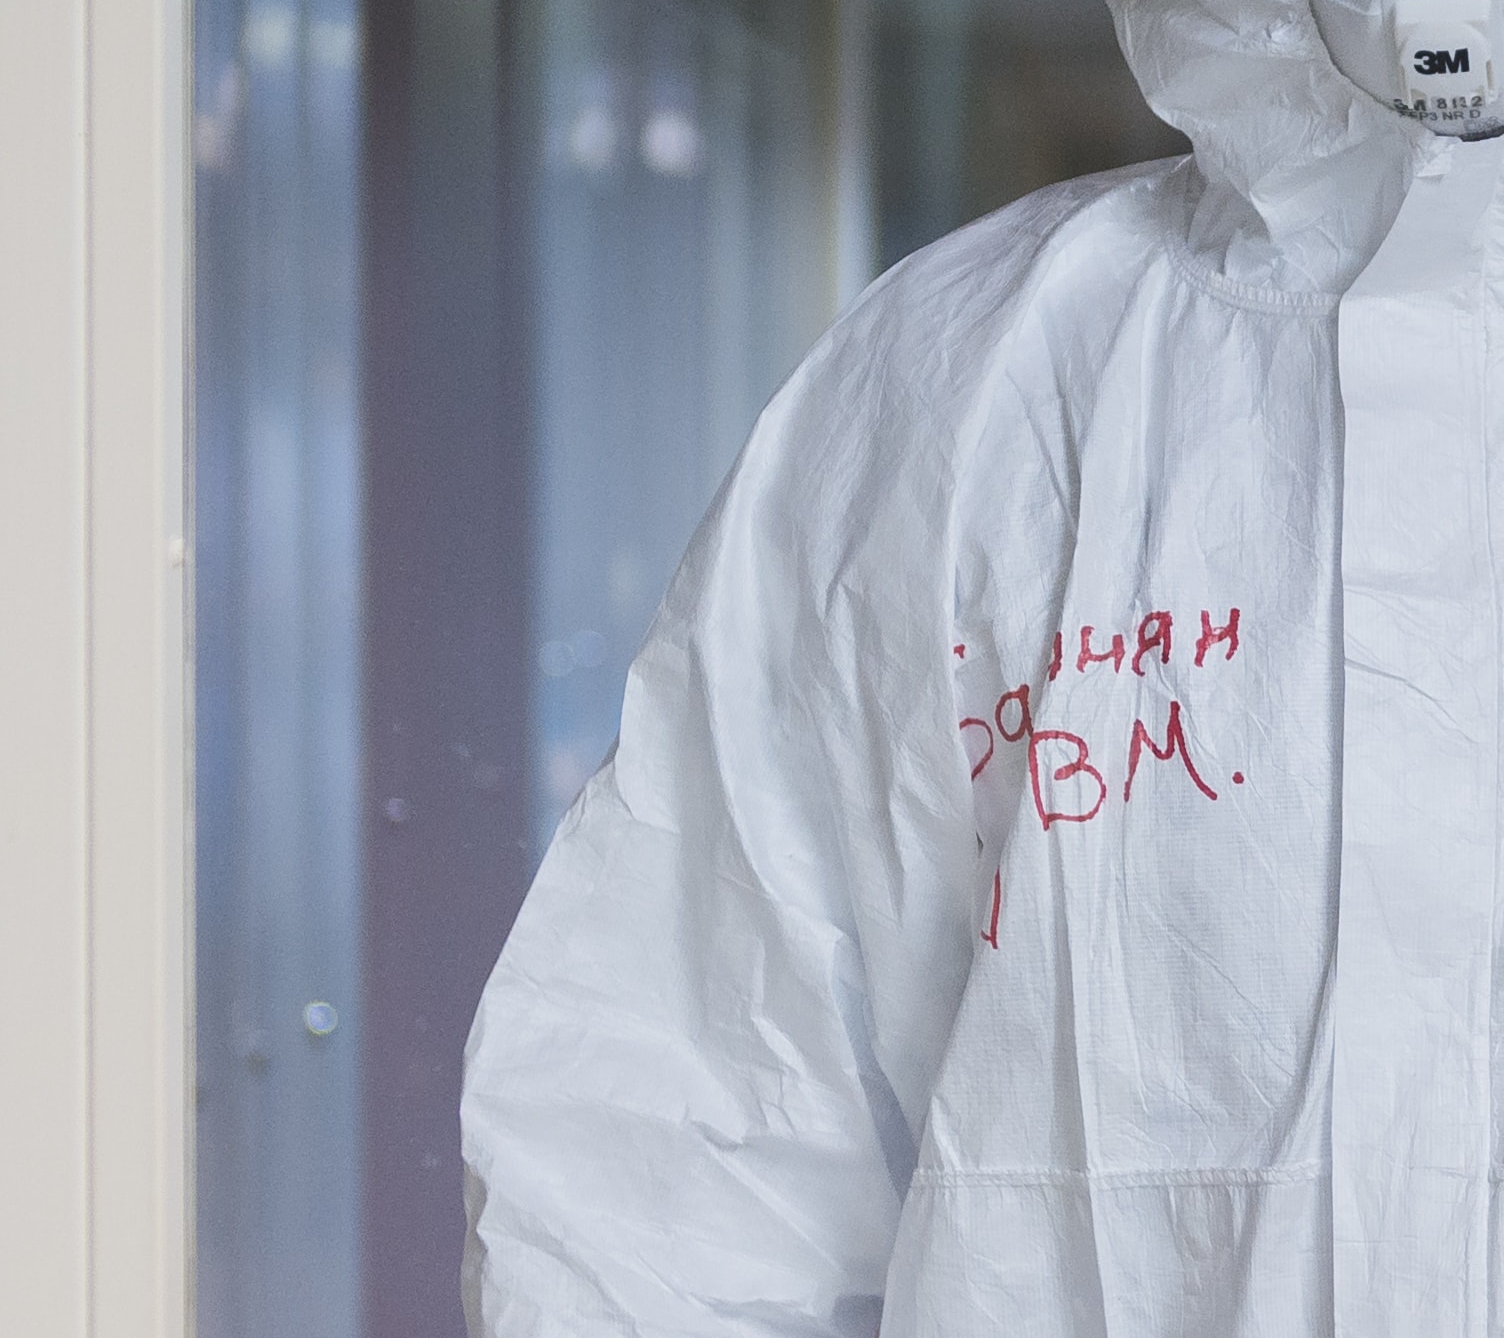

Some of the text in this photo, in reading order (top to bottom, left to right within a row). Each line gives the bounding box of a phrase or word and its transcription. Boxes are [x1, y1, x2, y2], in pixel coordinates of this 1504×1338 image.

[1413, 47, 1470, 75] 3M
[1442, 111, 1465, 121] NR
[1469, 109, 1481, 119] D
